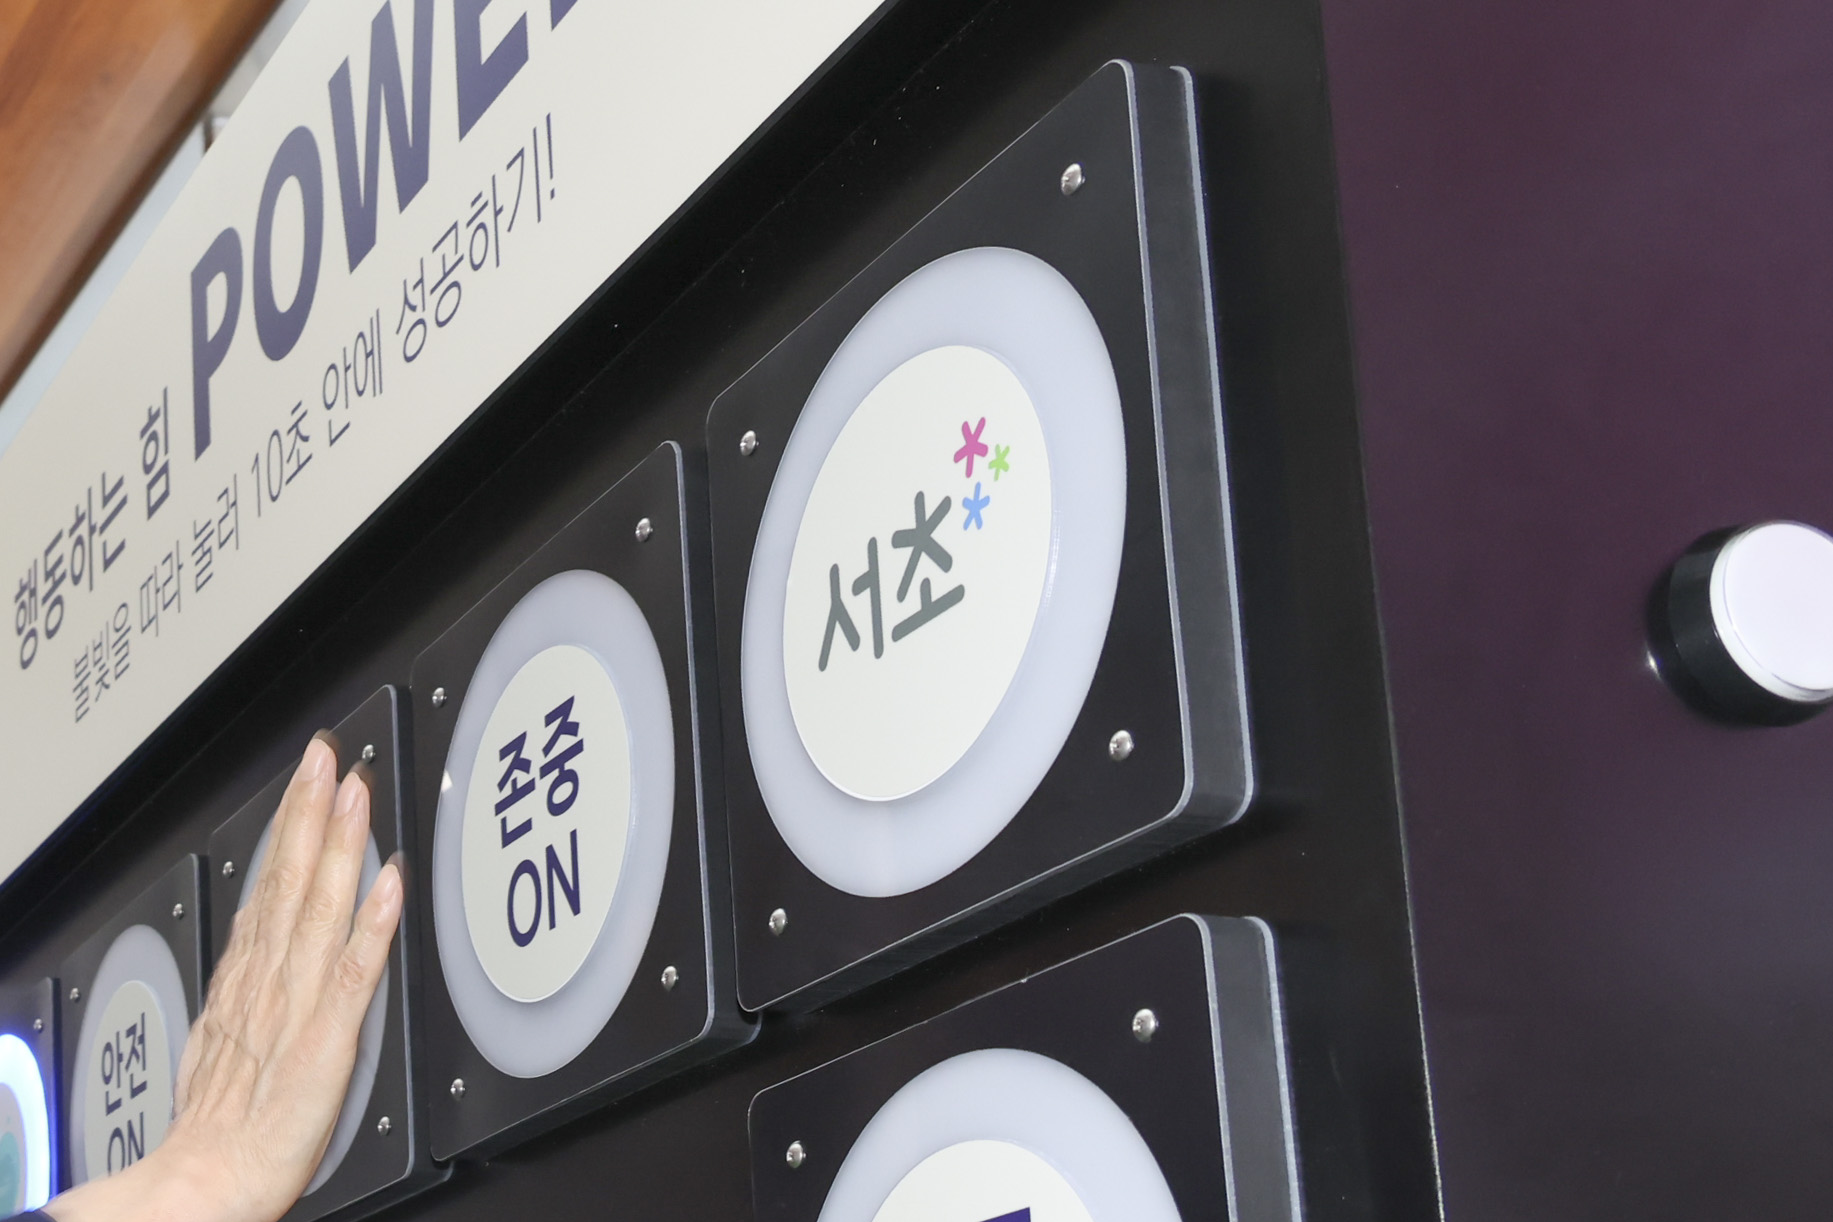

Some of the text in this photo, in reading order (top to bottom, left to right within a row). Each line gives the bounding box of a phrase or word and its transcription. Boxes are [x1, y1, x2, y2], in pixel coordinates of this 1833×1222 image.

[14, 0, 577, 670] 행동하는 힘 POWE
[72, 113, 555, 723] 불빛을 따라 눌러 10초 안에 성공하기!
[818, 490, 965, 672] 서초
[493, 695, 584, 849] 존중
[507, 828, 581, 947] ON
[101, 1012, 147, 1116] 안전
[107, 1111, 145, 1178] ON
